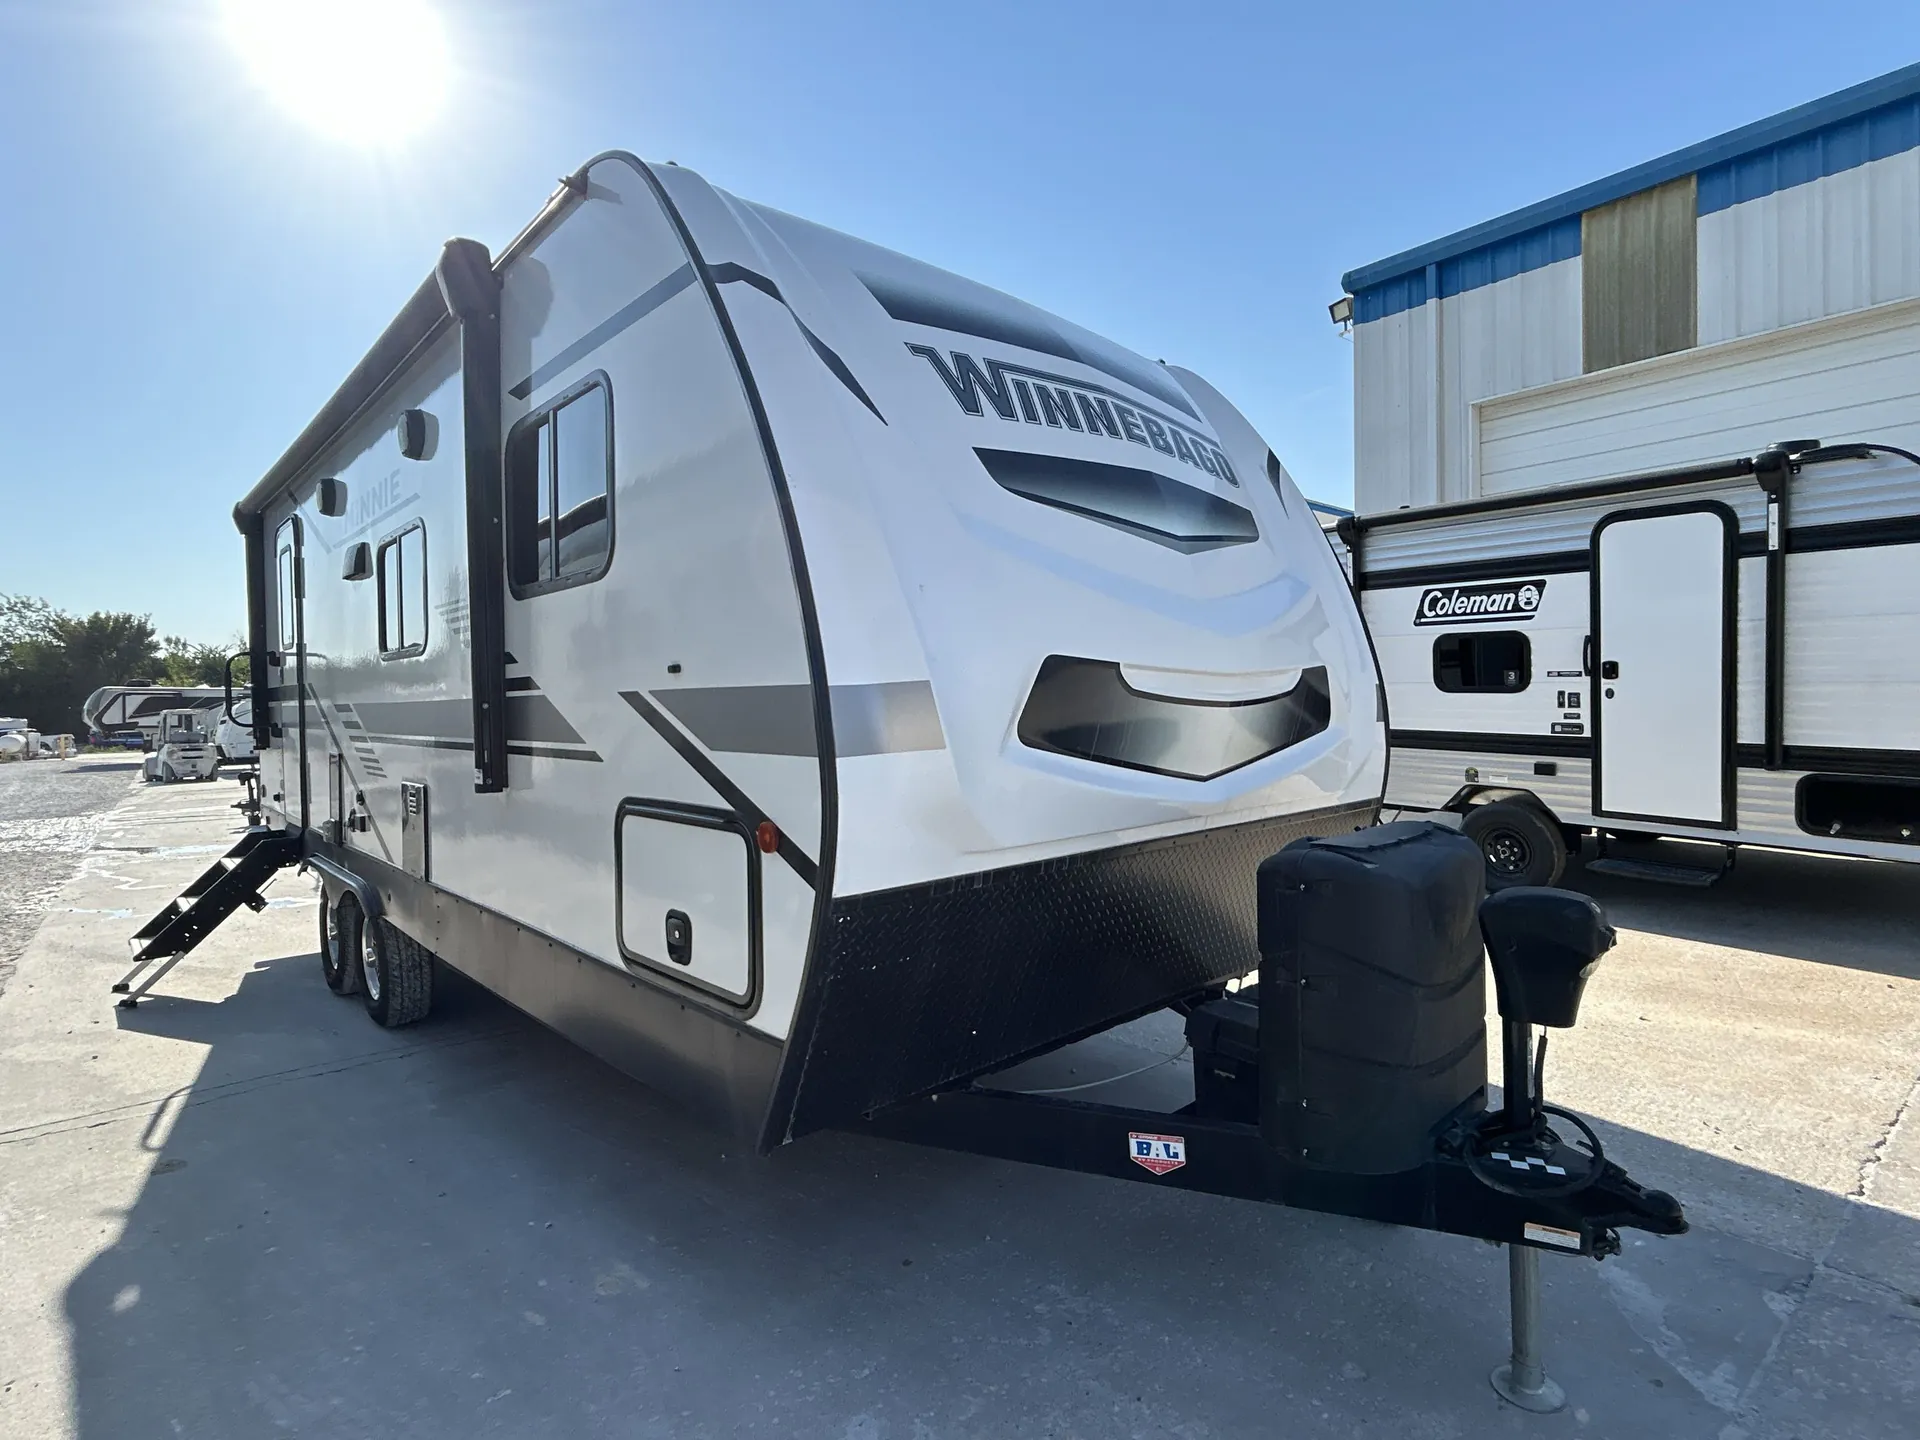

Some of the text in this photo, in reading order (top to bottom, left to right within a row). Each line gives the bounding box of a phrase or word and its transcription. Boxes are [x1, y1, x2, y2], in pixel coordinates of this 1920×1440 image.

[904, 341, 1240, 489] WINNEBAGO
[344, 468, 402, 534] INNIE
[1423, 589, 1516, 618] Coleman
[1508, 671, 1515, 680] 3
